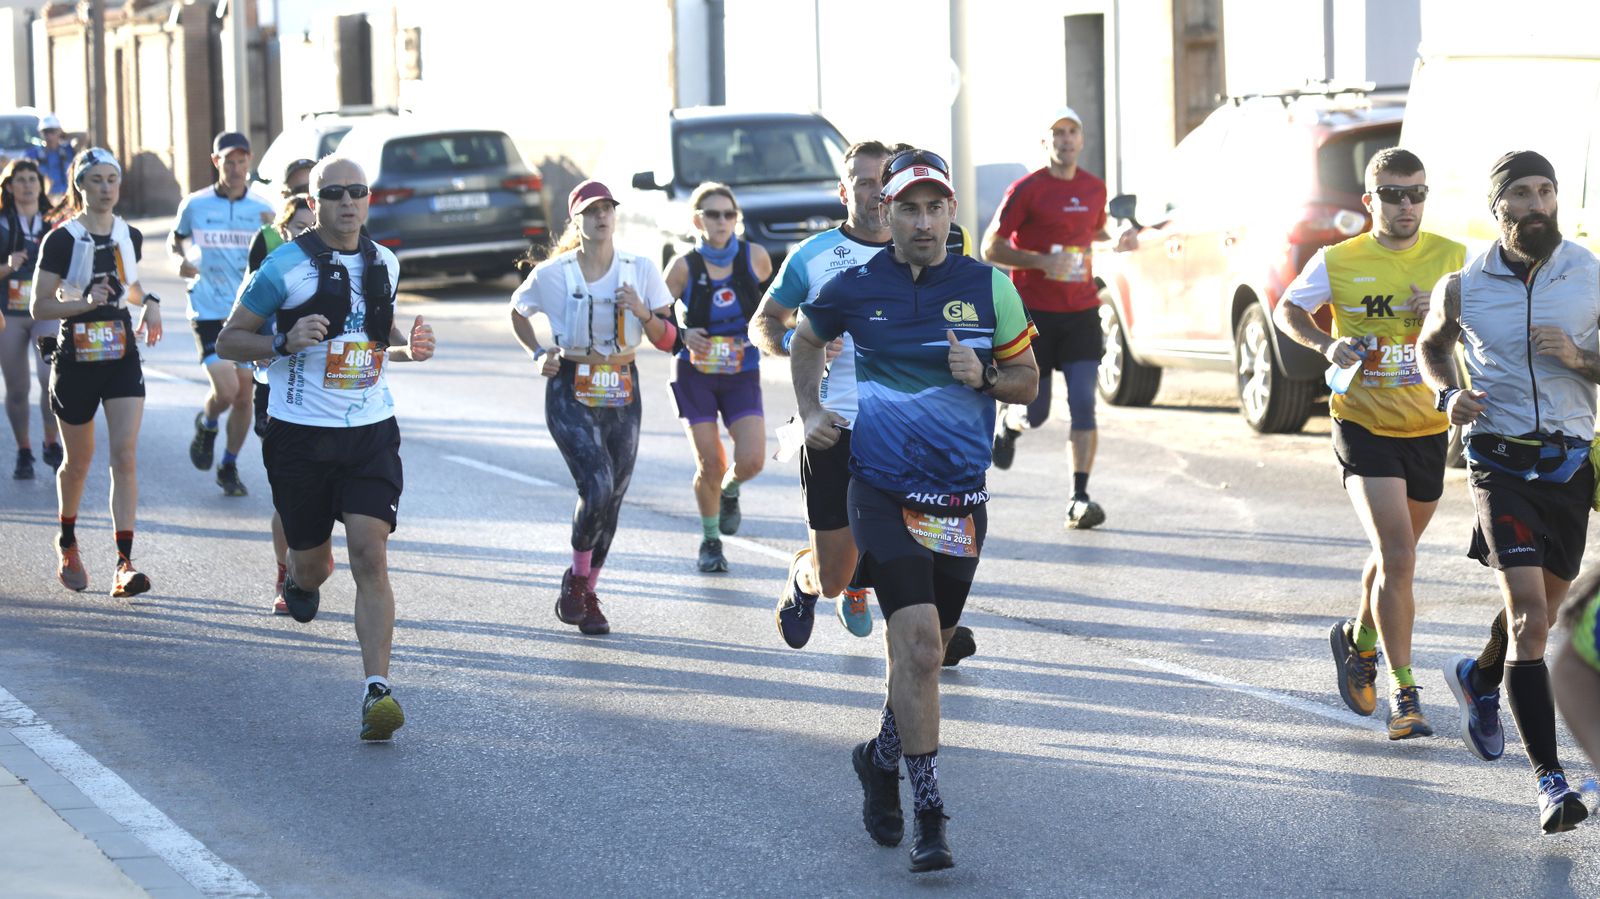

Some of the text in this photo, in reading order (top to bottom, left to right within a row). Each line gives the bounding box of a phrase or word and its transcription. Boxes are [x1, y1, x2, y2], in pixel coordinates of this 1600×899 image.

[830, 257, 858, 267] mundi
[87, 327, 114, 344] 545
[345, 349, 372, 366] 486
[591, 371, 620, 387] 400
[1363, 368, 1410, 377] Carbonerilla
[286, 386, 295, 404] COPA
[295, 388, 304, 406] COPA
[953, 534, 973, 545] 2023
